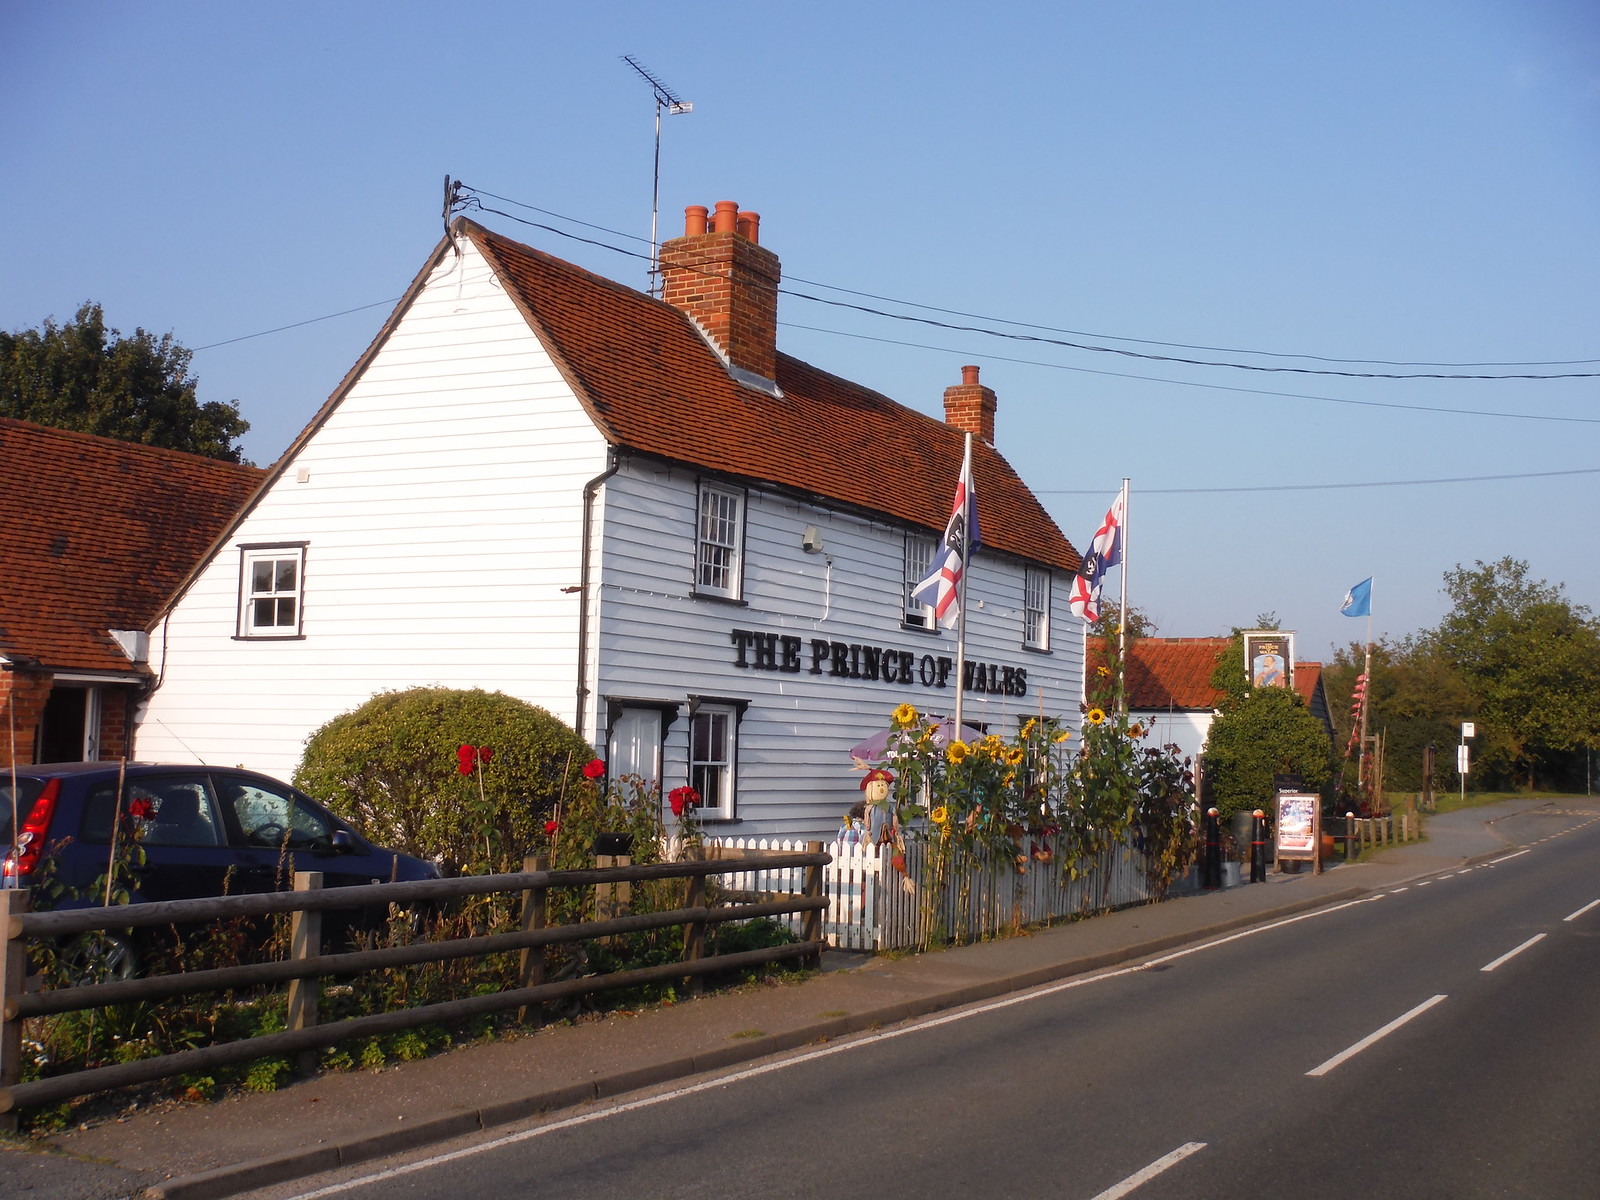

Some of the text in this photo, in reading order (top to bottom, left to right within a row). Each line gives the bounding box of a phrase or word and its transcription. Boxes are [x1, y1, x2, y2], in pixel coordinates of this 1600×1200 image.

[732, 629, 1027, 697] THE PRINCE OF WALES
